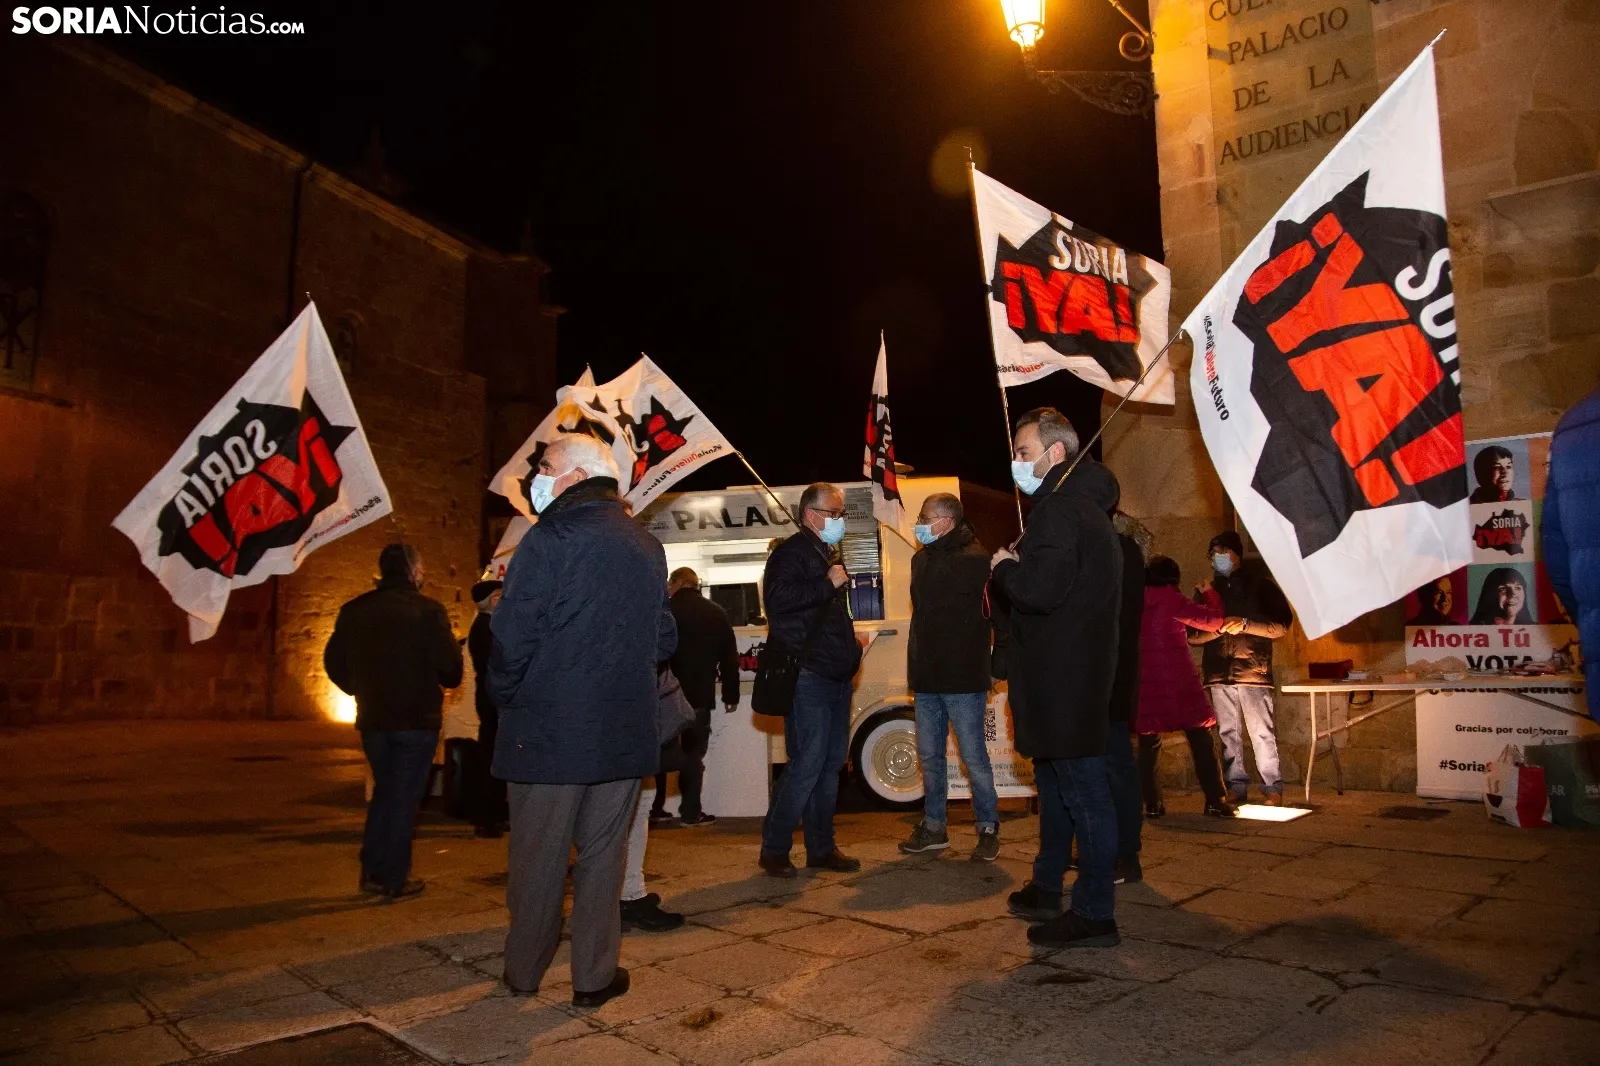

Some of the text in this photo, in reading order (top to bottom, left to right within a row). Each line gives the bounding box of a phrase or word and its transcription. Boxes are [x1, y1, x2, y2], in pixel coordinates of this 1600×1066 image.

[1208, 0, 1273, 21] CUL
[1226, 7, 1348, 65] PALACIO
[1233, 58, 1350, 112] DE LA
[1049, 230, 1129, 285] SORIA
[671, 503, 801, 531] PALACI
[1492, 517, 1522, 529] SORIA
[1412, 627, 1530, 647] Ahora Tú
[1455, 724, 1493, 733] Gracias
[1496, 727, 1513, 735] por
